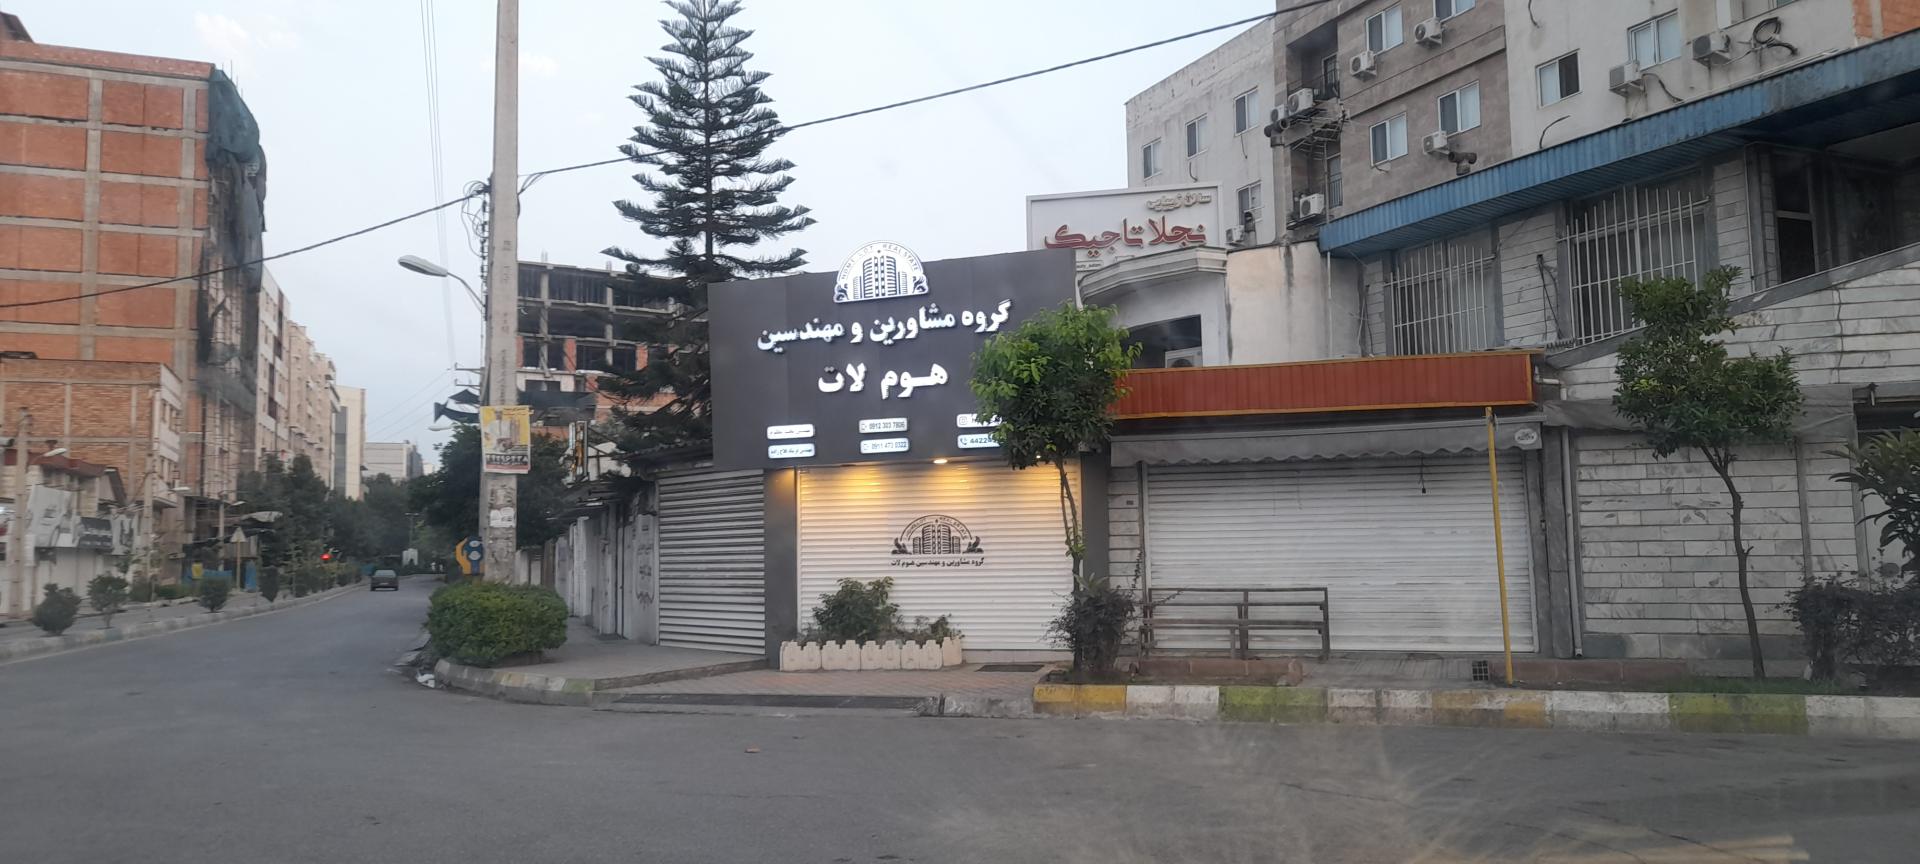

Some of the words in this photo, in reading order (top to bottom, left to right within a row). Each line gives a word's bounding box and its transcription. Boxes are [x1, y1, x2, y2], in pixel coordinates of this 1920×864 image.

[1044, 218, 1144, 258] تاجیک
[1149, 215, 1207, 247] نجلا
[850, 321, 864, 343] و
[869, 302, 955, 345] مشاورین
[960, 299, 1012, 333] گروه
[757, 318, 845, 353] مهندسین
[817, 362, 867, 393] لات
[881, 363, 949, 400] هوم
